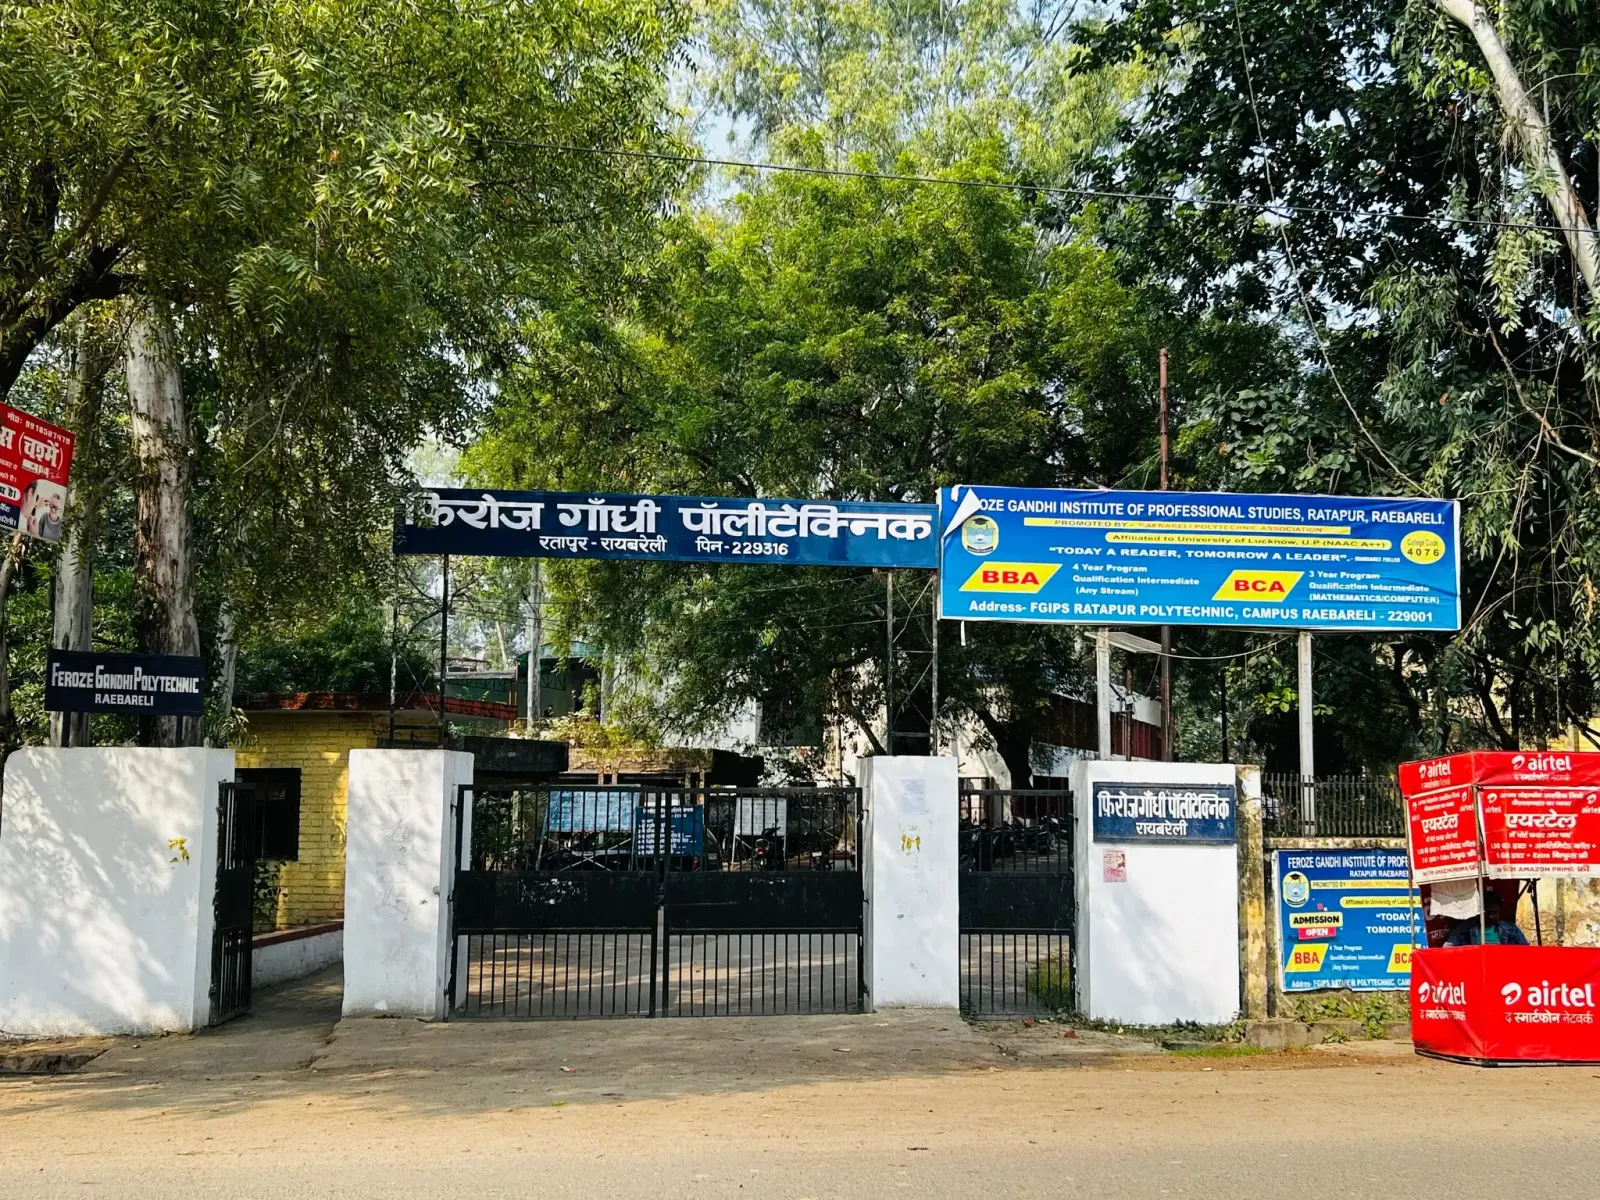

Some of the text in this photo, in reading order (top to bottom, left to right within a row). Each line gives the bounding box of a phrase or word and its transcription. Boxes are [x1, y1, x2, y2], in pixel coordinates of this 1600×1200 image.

[556, 497, 661, 534] गाँधी
[979, 498, 1445, 525] OZE GANDHI INSTITUTE OF PROFESSIONAL STUDIES, RATAPUR, RAEBARELI.
[1054, 519, 1112, 528] PROMOTED
[1260, 525, 1323, 533] ASSOCIATION
[1112, 534, 1161, 542] Affiliated
[1178, 536, 1231, 545] University
[1361, 541, 1386, 549] A++)
[1106, 547, 1117, 556] A
[1123, 547, 1181, 558] READER,
[1185, 549, 1268, 561] TOMORROW
[1271, 551, 1283, 560] A
[1081, 564, 1104, 572] Year
[1105, 565, 1148, 574] Program
[1317, 571, 1338, 579] Year
[1339, 572, 1380, 581] Program
[982, 570, 1040, 585] BBA
[1072, 575, 1200, 586] Qualification Intermediate
[1075, 587, 1139, 597] (Any Stream)
[1234, 579, 1285, 593] BCA
[1309, 581, 1430, 593] Qualification Intermediate
[969, 600, 1027, 614] Address-
[1030, 602, 1070, 614] FGIPS
[1073, 603, 1136, 616] RATAPUR
[1140, 605, 1239, 620] POLYTECHNIC,
[1242, 607, 1298, 620] CAMPUS
[1302, 608, 1376, 621] RAEBARELI
[1387, 610, 1433, 622] 229001
[51, 662, 199, 694] FEROZE GANDHI POLYTECHNIC
[95, 693, 154, 706] RAEBARELI
[1427, 760, 1452, 778] airtel
[1527, 753, 1572, 771] airtel
[1421, 811, 1459, 834] एयरटेल
[1504, 808, 1578, 828] एयरटेल
[1135, 820, 1188, 836] रायबरेली
[1288, 857, 1315, 868] FEROZE
[1315, 857, 1341, 868] GANDHI
[1342, 855, 1376, 868] INSTITUTE
[1377, 856, 1386, 867] OF
[1349, 870, 1377, 878] RATAPUR
[1293, 915, 1339, 925] ADMISSION
[1305, 928, 1328, 937] OPEN
[1294, 952, 1320, 965] BBA
[1431, 980, 1467, 1005] airtel
[1528, 980, 1595, 1007] airtel
[1504, 1009, 1594, 1024] द स्मार्टफोन नेटवर्क
